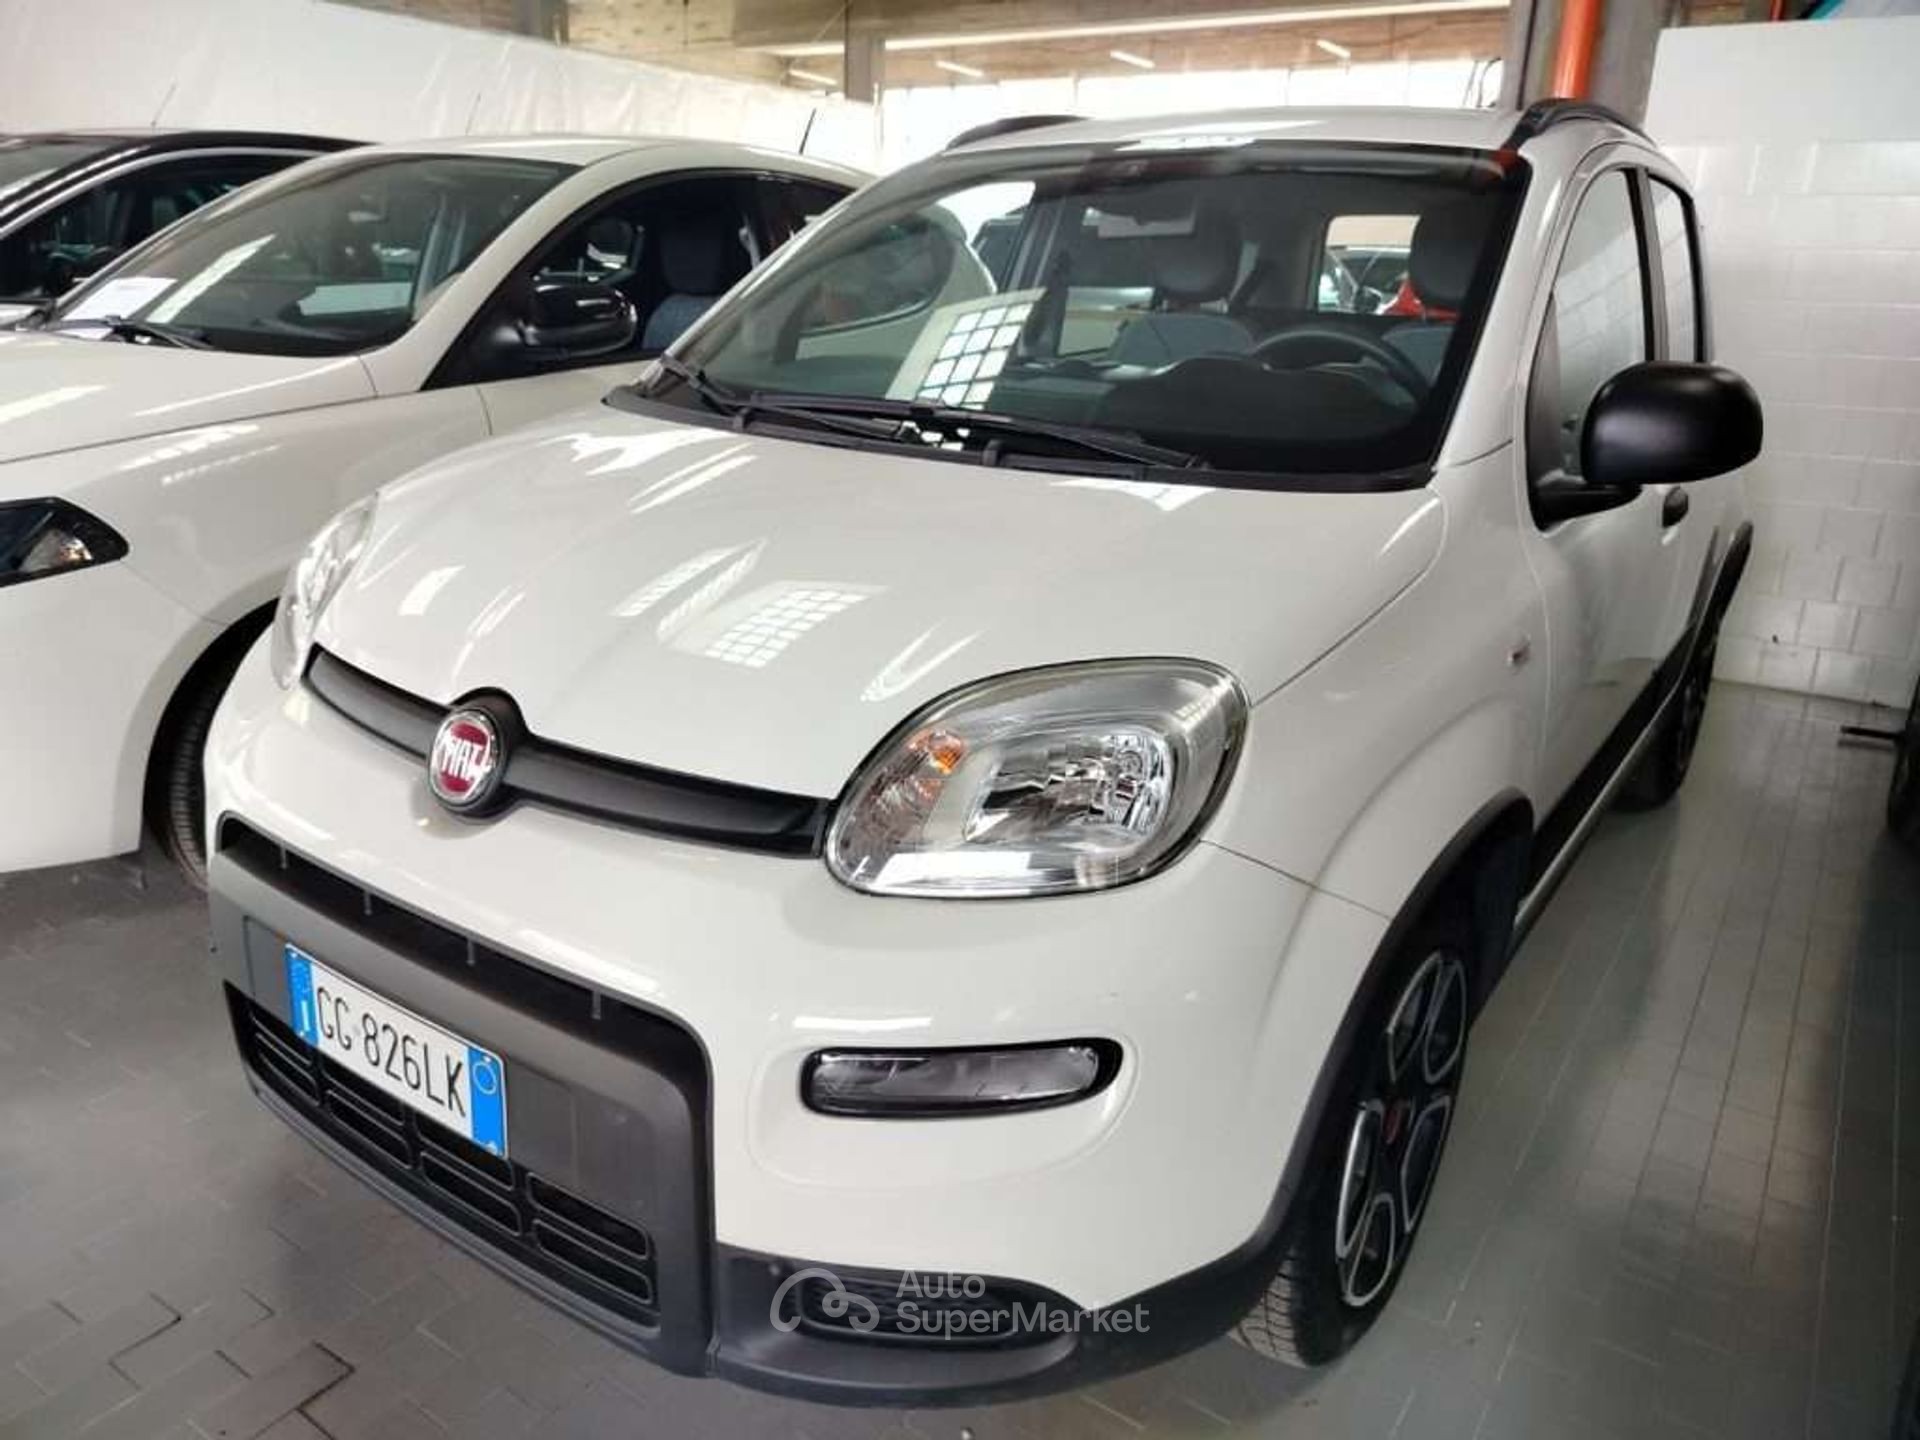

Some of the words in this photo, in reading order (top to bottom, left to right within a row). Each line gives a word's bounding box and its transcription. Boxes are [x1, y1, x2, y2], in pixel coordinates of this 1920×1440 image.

[440, 735, 487, 782] FIAT
[317, 987, 352, 1050] GG
[362, 1013, 466, 1118] 826LK
